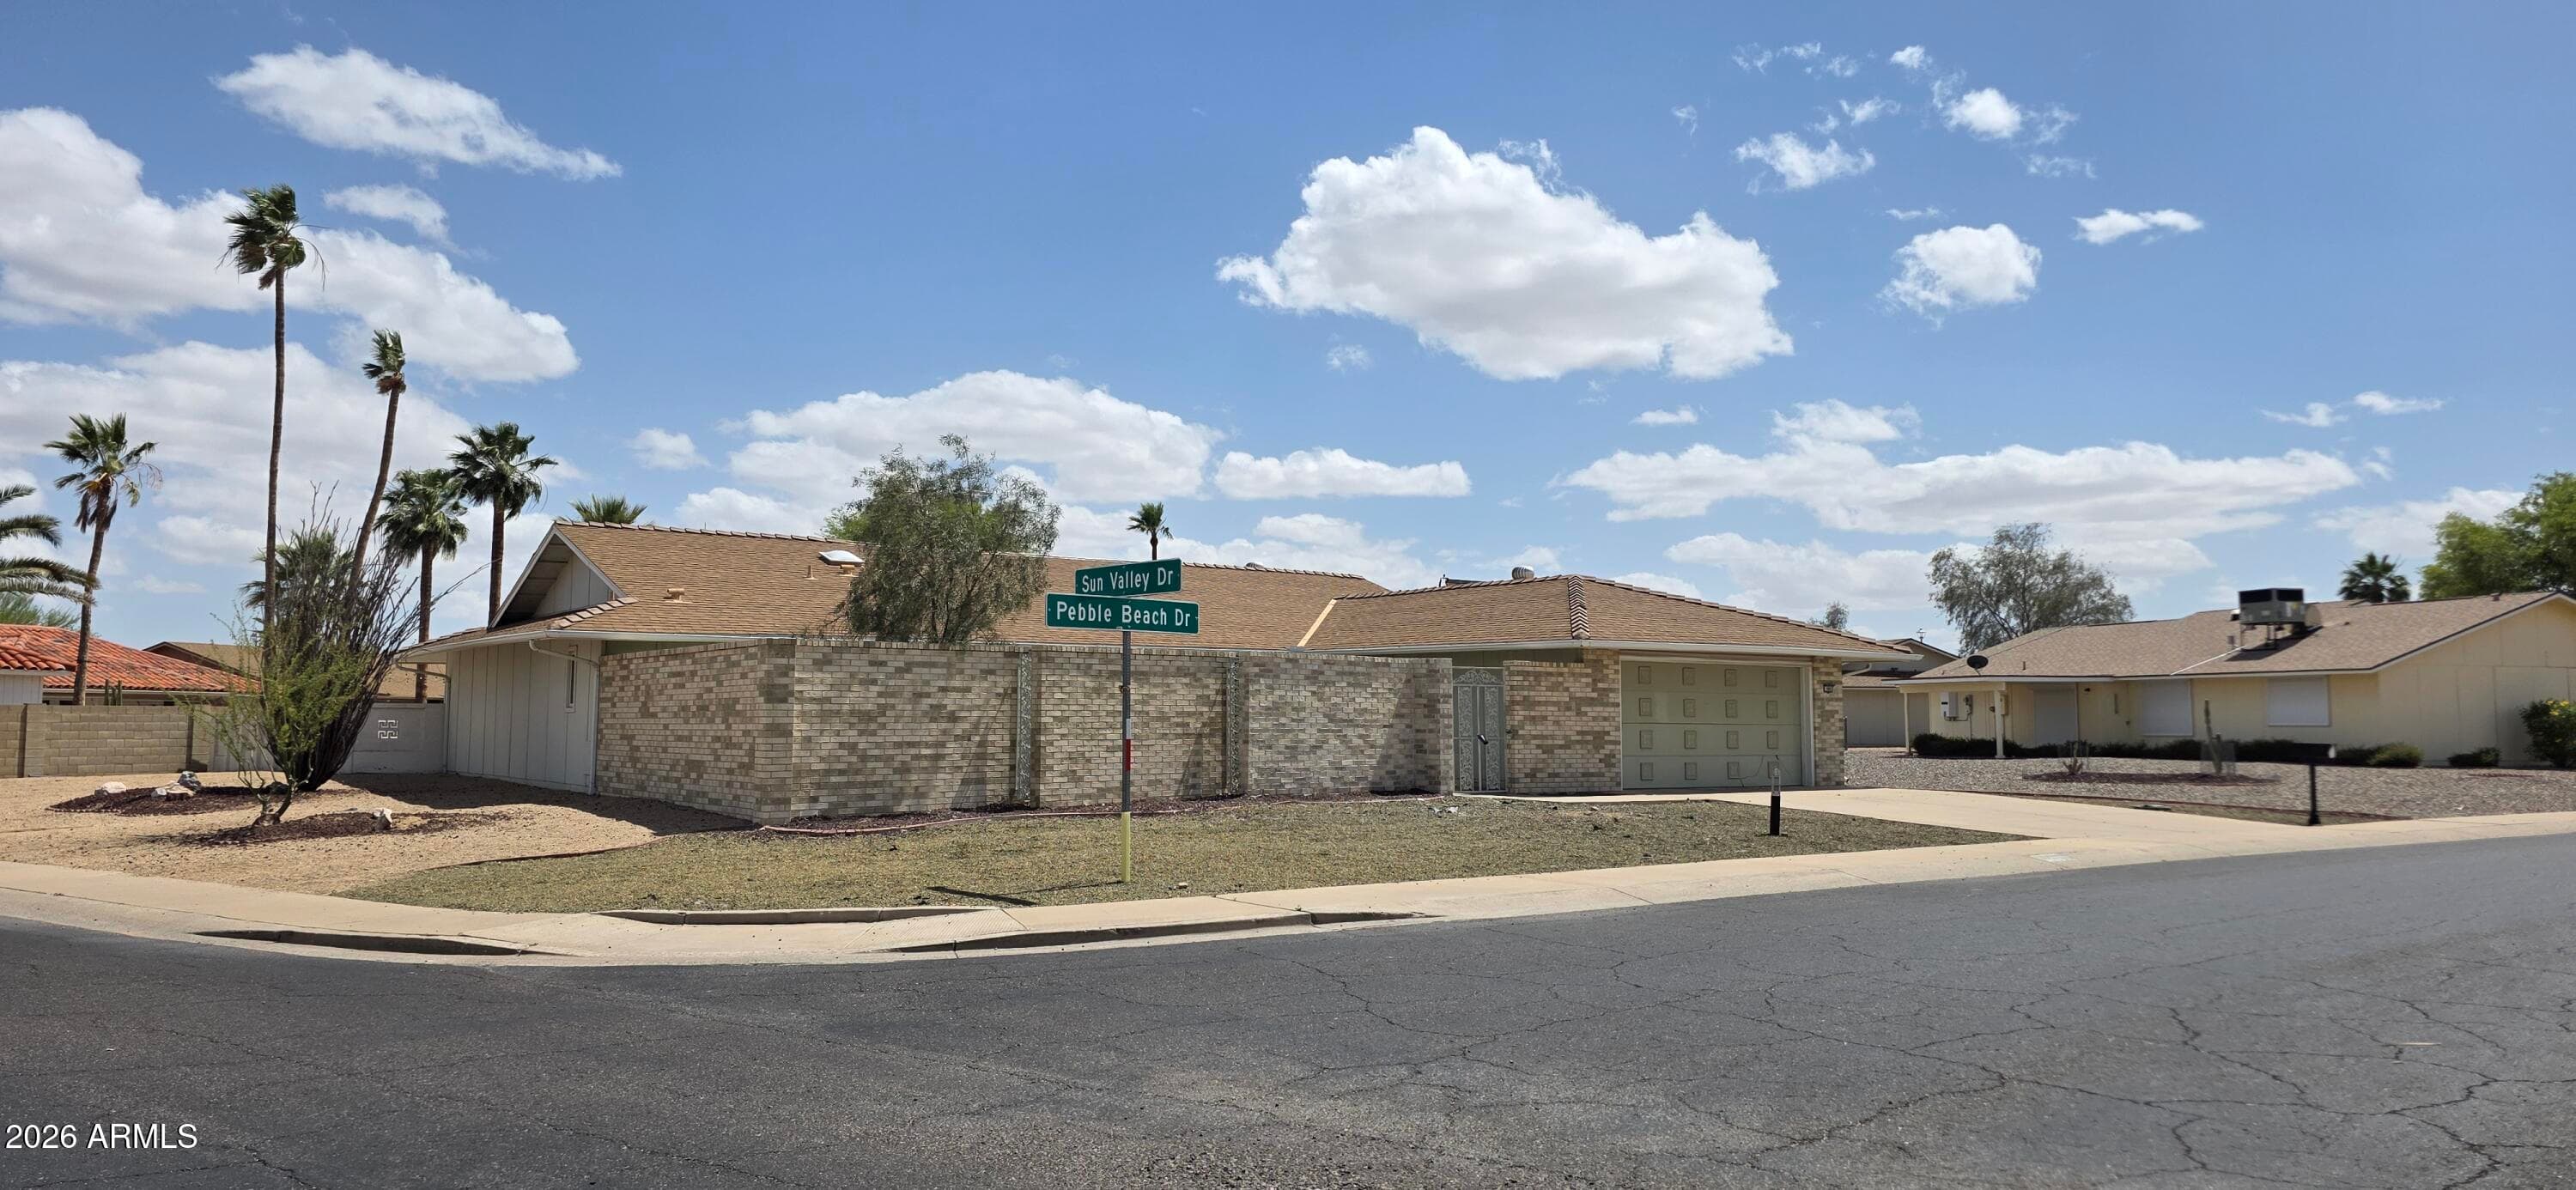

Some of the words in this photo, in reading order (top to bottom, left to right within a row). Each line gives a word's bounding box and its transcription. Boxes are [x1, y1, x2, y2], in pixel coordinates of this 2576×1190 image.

[1082, 574, 1103, 592] Sun
[1109, 570, 1150, 592] Valley
[1157, 567, 1174, 586] Dr
[1056, 601, 1112, 622] Pebble
[1121, 604, 1167, 626] Beach
[1175, 608, 1191, 627] Dr
